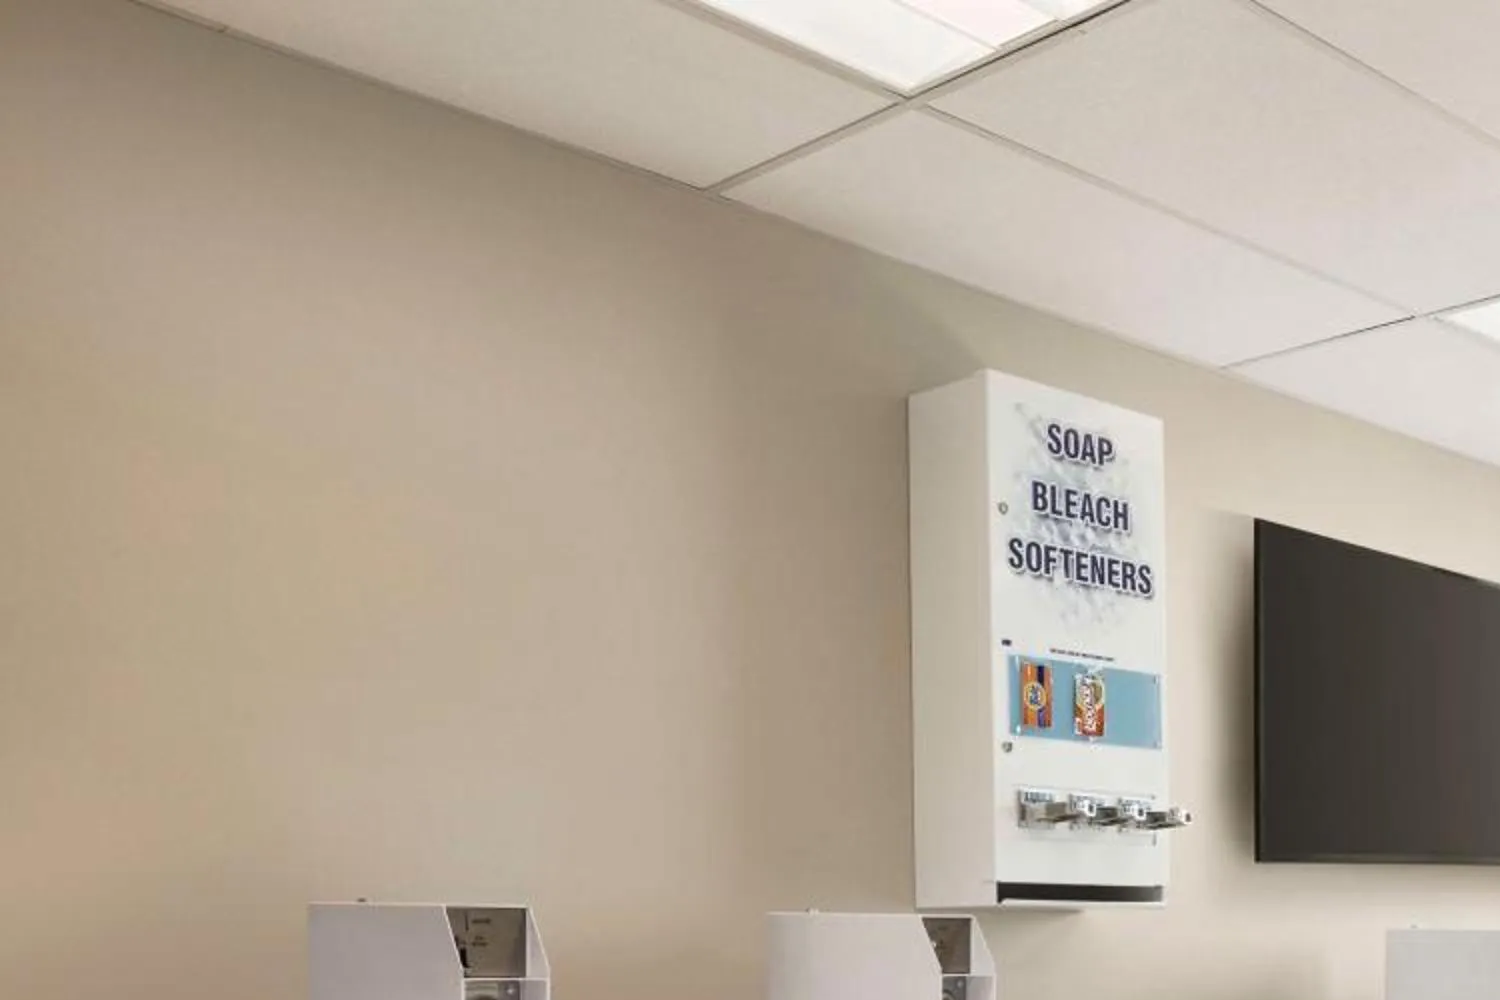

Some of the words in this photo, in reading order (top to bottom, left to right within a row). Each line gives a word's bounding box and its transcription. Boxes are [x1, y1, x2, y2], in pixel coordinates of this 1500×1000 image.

[1047, 423, 1113, 466] SOAP
[1032, 480, 1129, 531] BLEACH
[1008, 537, 1151, 595] SOFTENERS
